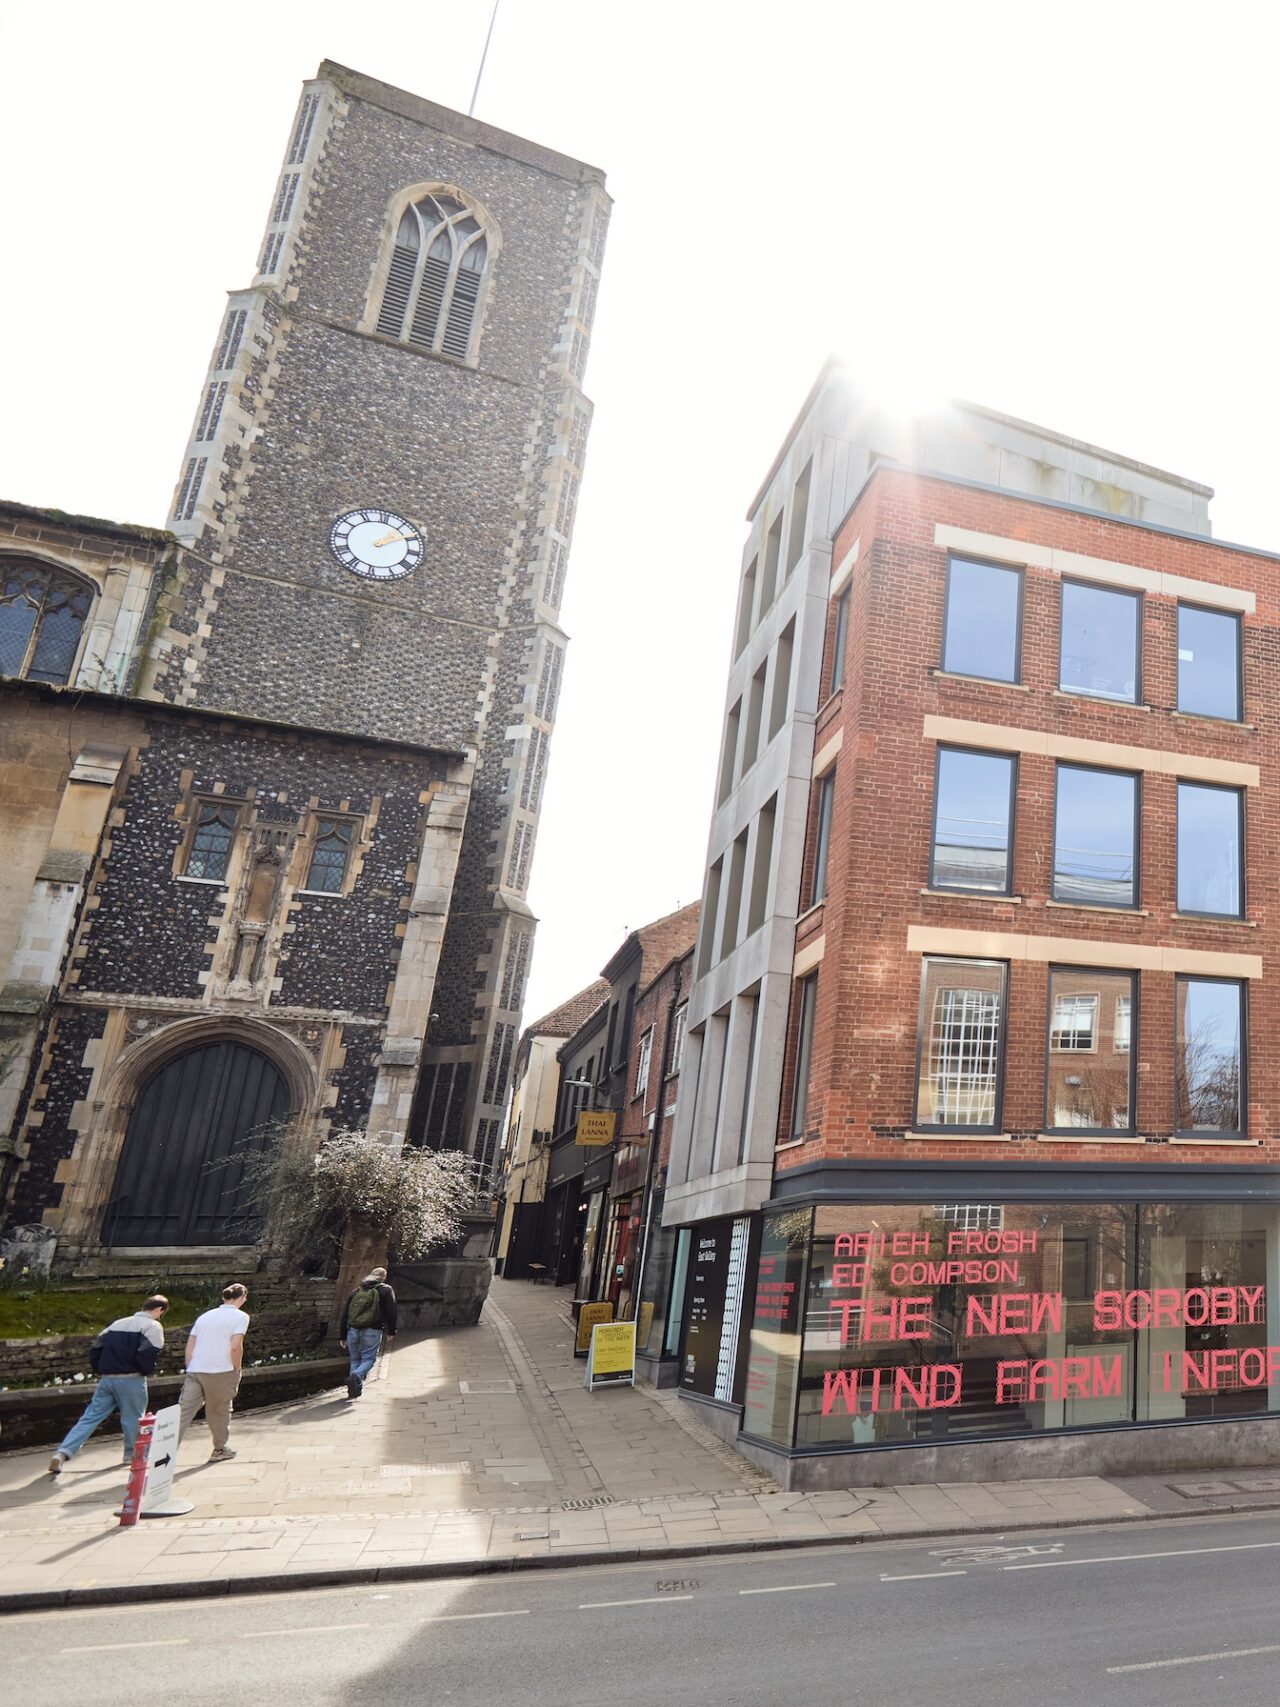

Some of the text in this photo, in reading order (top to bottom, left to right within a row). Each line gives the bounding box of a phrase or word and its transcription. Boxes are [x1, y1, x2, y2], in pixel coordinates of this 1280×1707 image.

[581, 1128, 609, 1136] LANNA
[587, 1119, 606, 1127] THAI
[834, 1230, 1037, 1257] ARIEH FROSH
[831, 1259, 1019, 1288] ED COMPSON
[827, 1295, 933, 1344] THE
[965, 1292, 1062, 1338] NEW
[1093, 1286, 1265, 1332] SCROBY
[821, 1363, 963, 1416] WIND
[995, 1356, 1122, 1404] FARM
